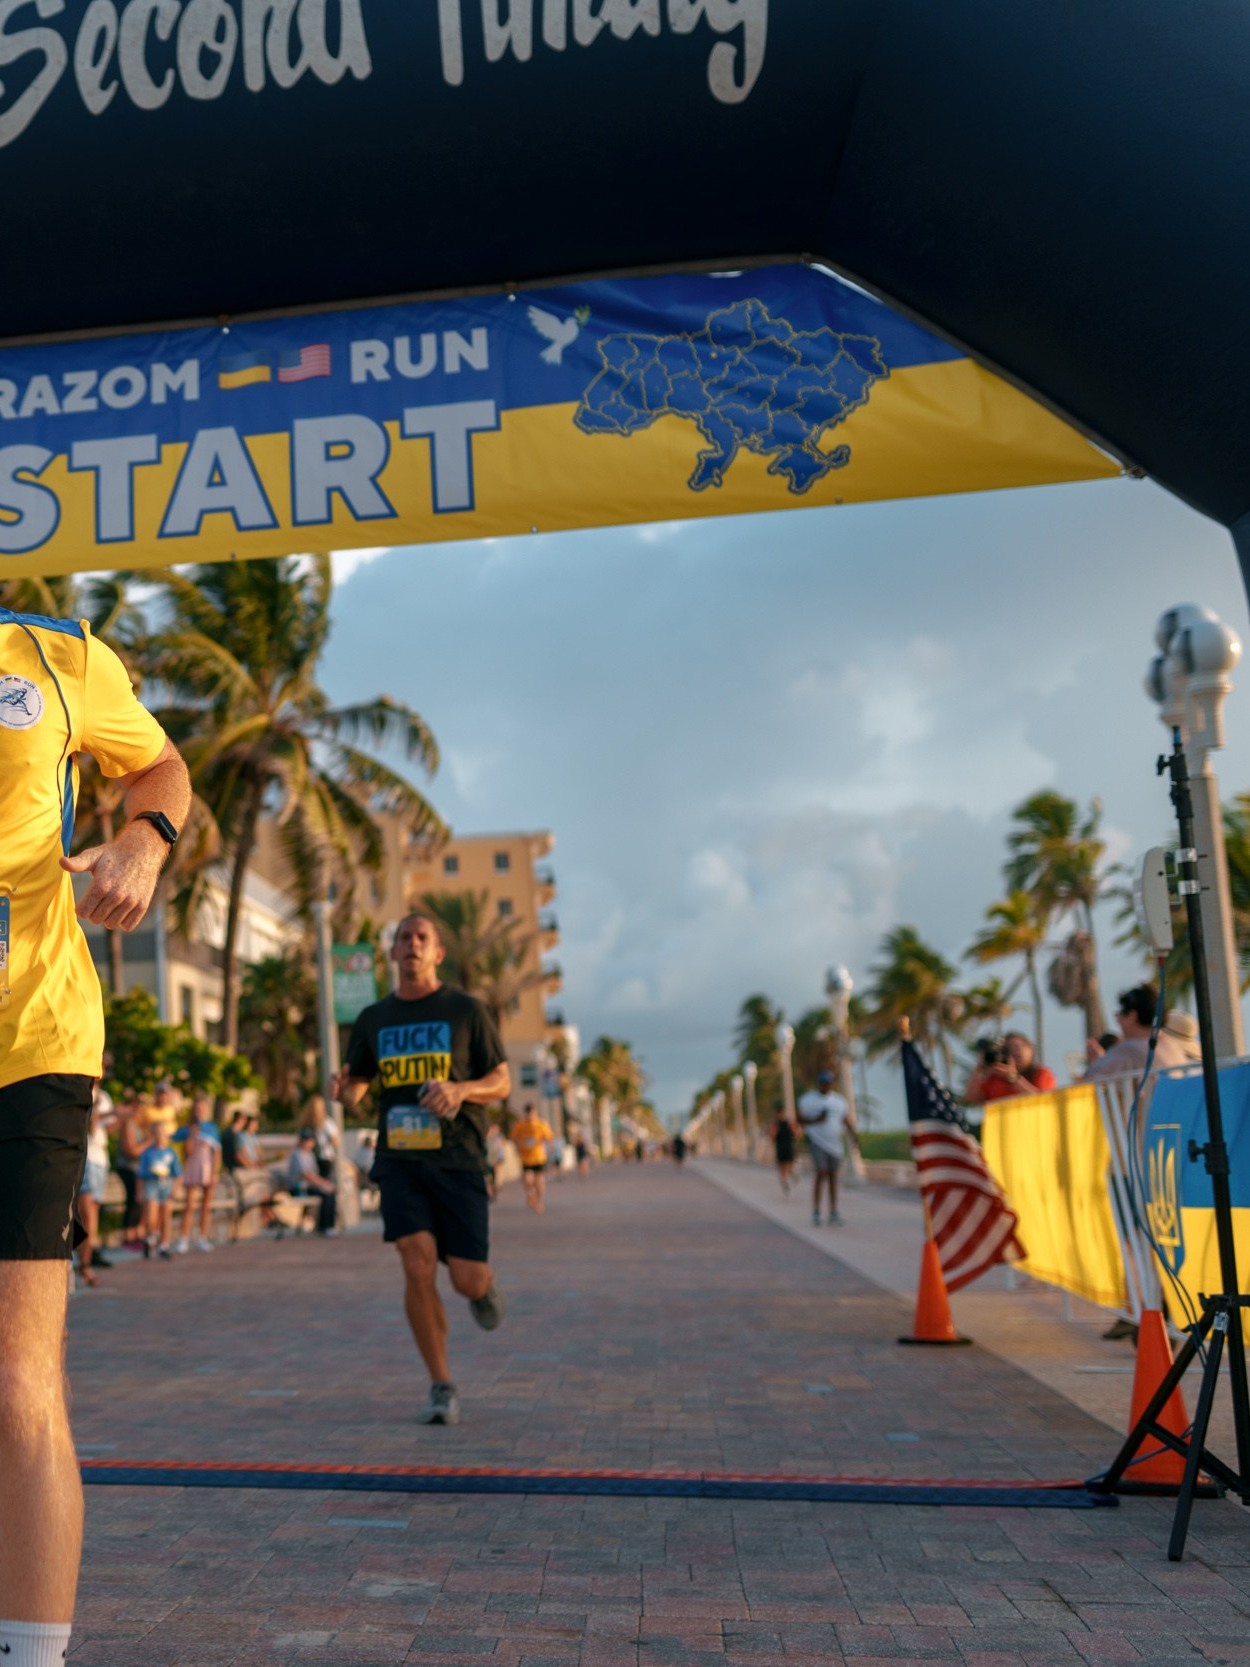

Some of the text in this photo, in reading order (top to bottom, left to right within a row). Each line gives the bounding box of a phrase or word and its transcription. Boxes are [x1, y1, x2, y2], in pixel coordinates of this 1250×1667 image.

[350, 326, 489, 385] RUN
[381, 1024, 446, 1054] FUCK
[382, 1055, 446, 1083] PUTIN
